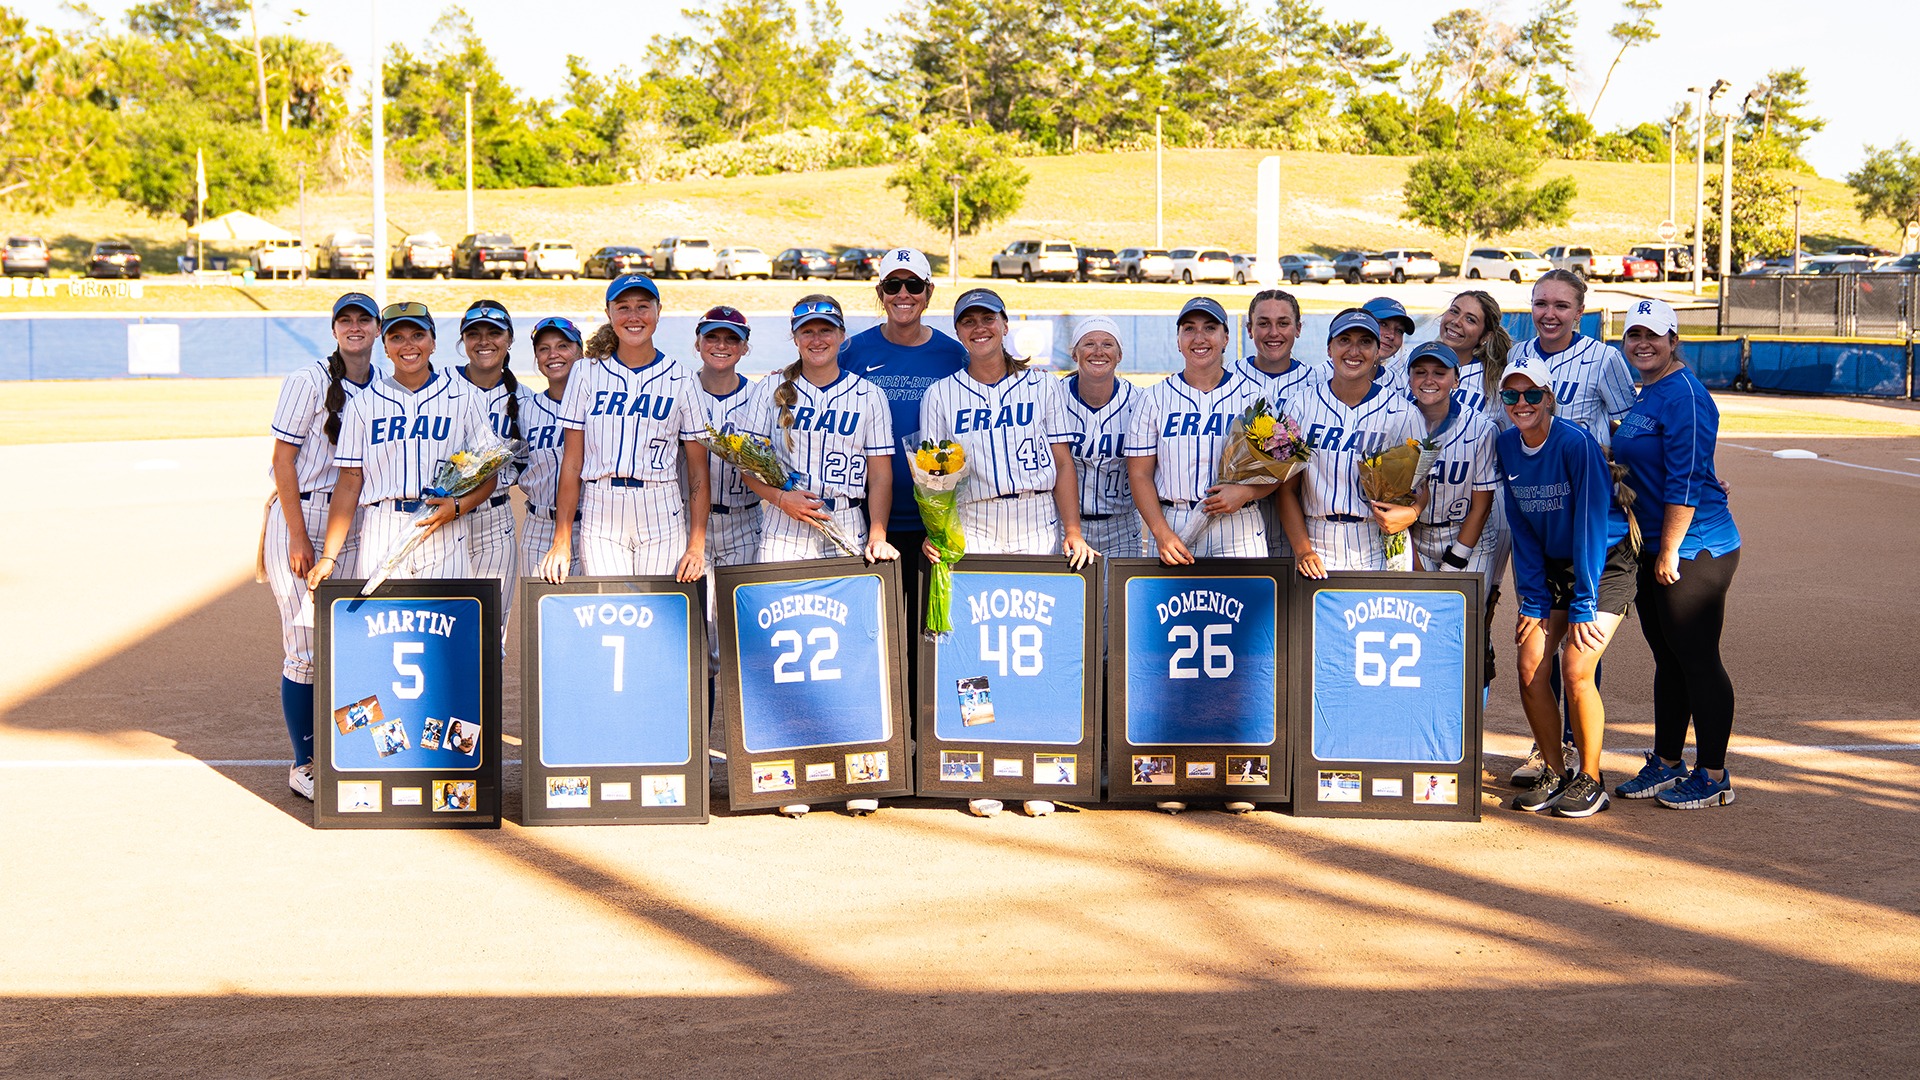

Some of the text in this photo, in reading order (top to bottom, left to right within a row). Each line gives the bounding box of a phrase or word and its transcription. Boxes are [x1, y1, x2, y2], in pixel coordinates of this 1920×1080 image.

[590, 390, 675, 421] ERAU
[954, 401, 1034, 434] ERAU
[371, 415, 452, 445] ERAU
[1068, 432, 1126, 458] RAU
[649, 438, 668, 469] 7
[824, 451, 867, 486] 22
[1017, 436, 1051, 470] 48
[1447, 497, 1470, 521] 9
[364, 610, 456, 638] MARTIN
[573, 603, 654, 629] WOOD
[757, 593, 849, 630] OBERKEHR
[968, 588, 1056, 626] MORSE
[1156, 590, 1244, 625] DOMENICI
[1344, 596, 1432, 633] DOMENICI
[601, 635, 625, 692] 7
[770, 626, 842, 684] 22
[979, 624, 1044, 677] 48
[1167, 623, 1235, 679] 26
[1355, 631, 1421, 688] 62
[392, 641, 424, 699] 5
